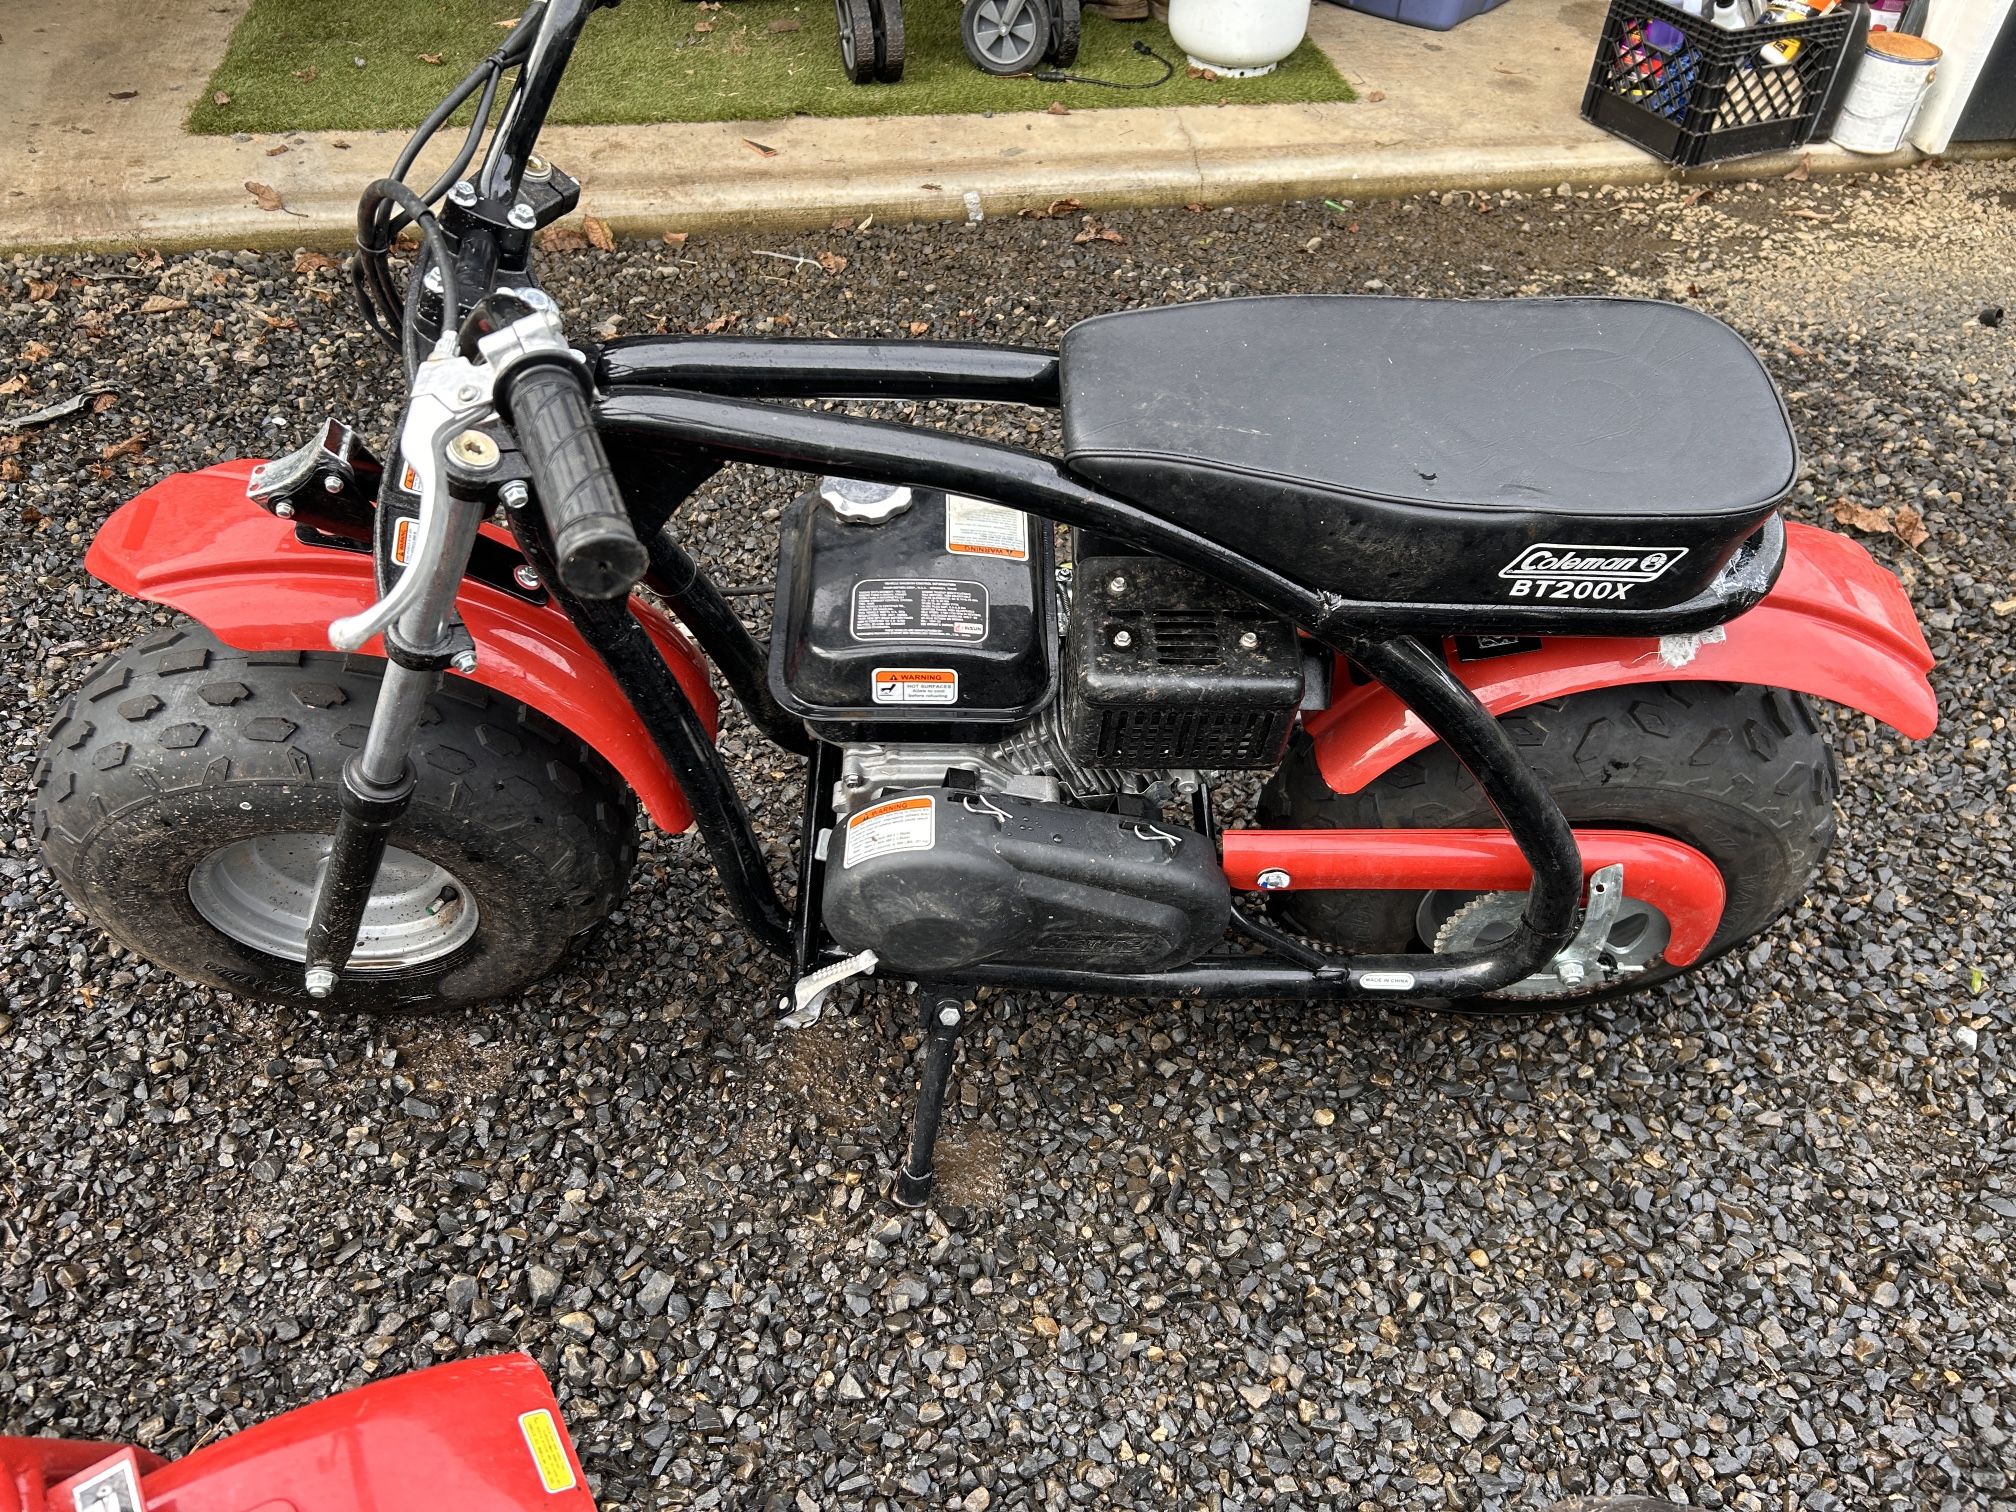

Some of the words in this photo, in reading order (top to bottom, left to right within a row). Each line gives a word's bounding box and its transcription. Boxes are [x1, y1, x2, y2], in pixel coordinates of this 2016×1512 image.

[964, 545, 1004, 554] WARNING
[1520, 550, 1639, 571] Coleman
[1508, 579, 1636, 600] BT200X
[871, 802, 908, 817] WARNING
